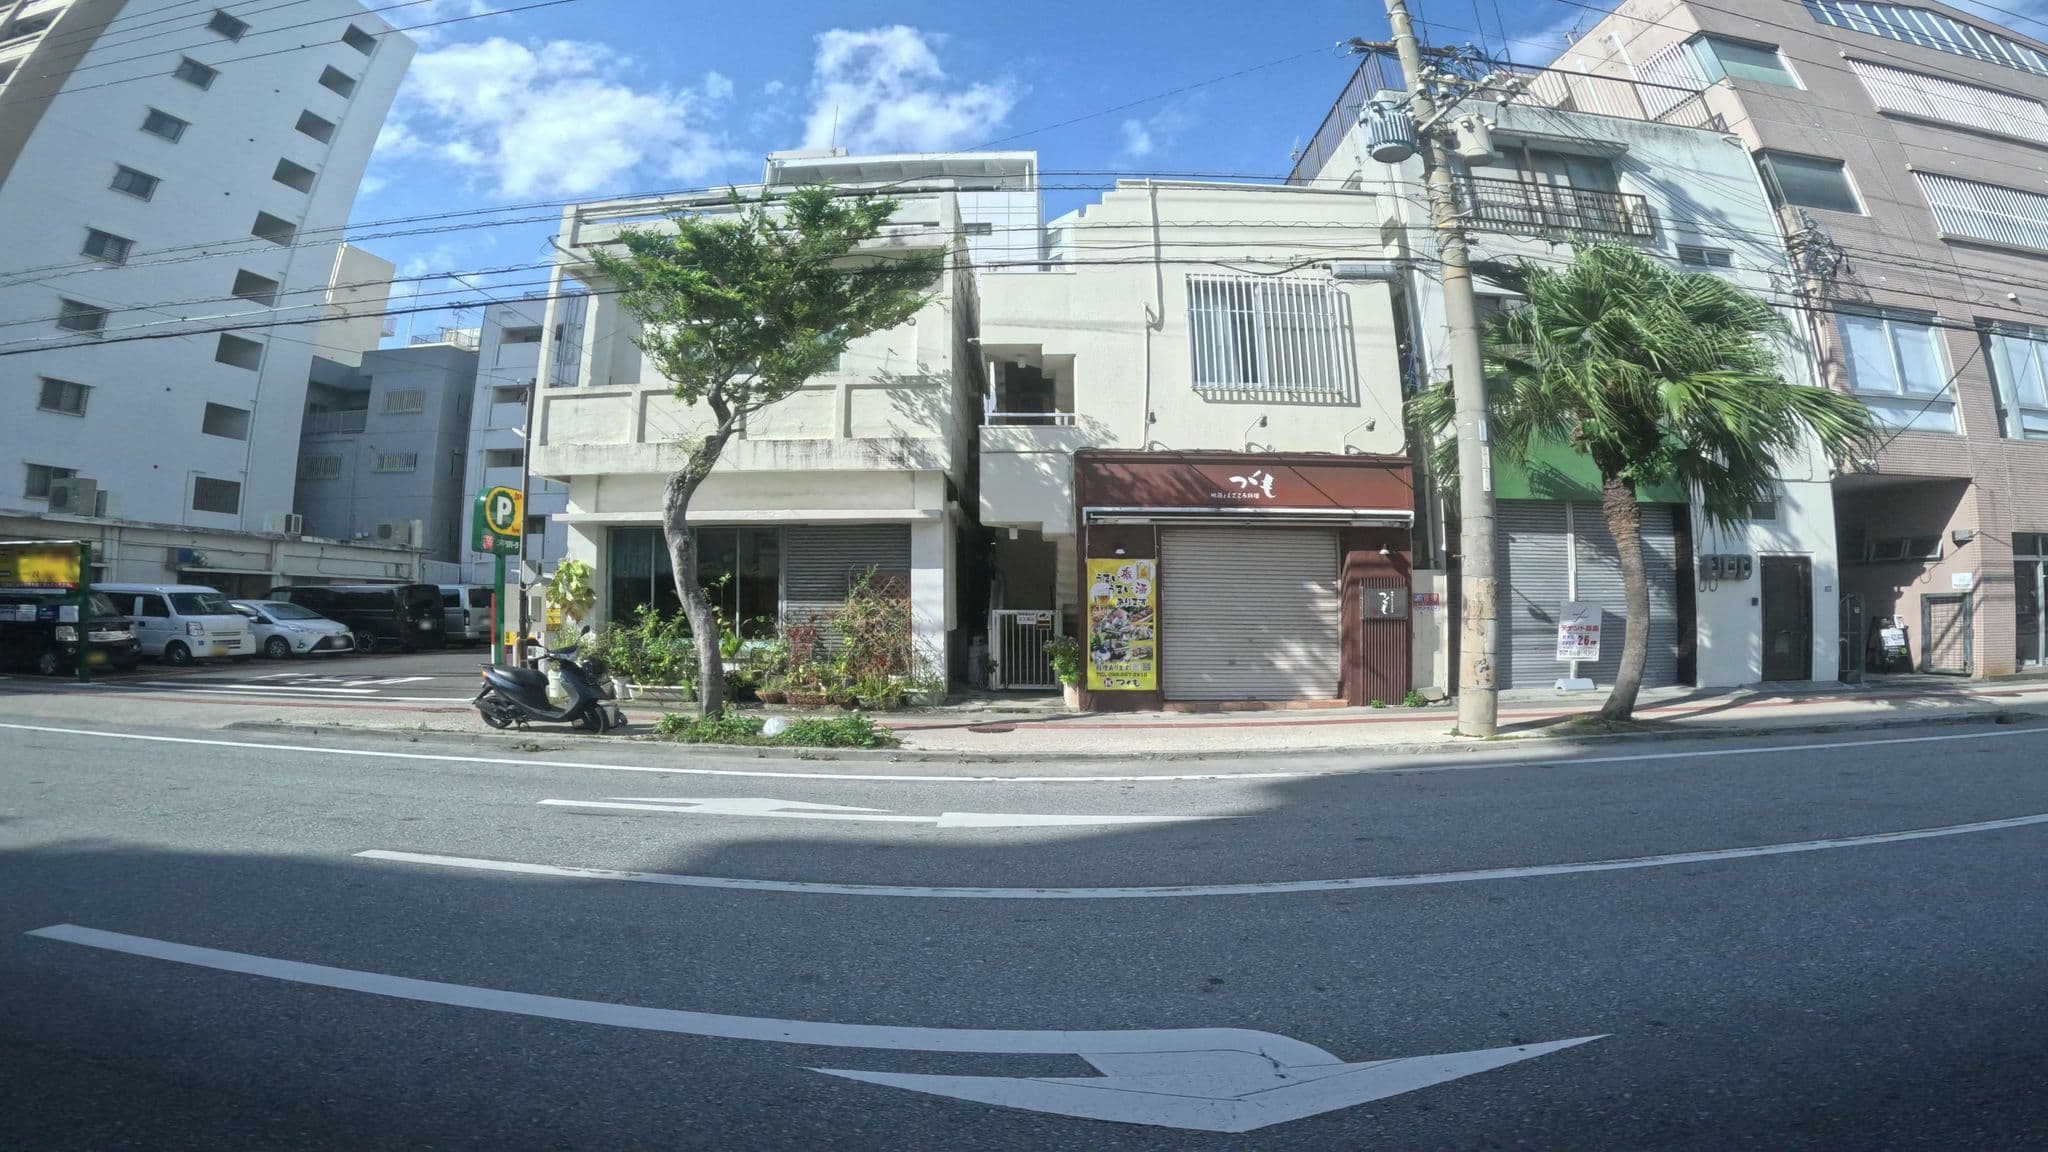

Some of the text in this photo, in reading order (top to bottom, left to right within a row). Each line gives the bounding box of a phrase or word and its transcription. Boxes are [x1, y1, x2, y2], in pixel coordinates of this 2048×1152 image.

[1228, 469, 1277, 498] つくも
[496, 495, 512, 525] P
